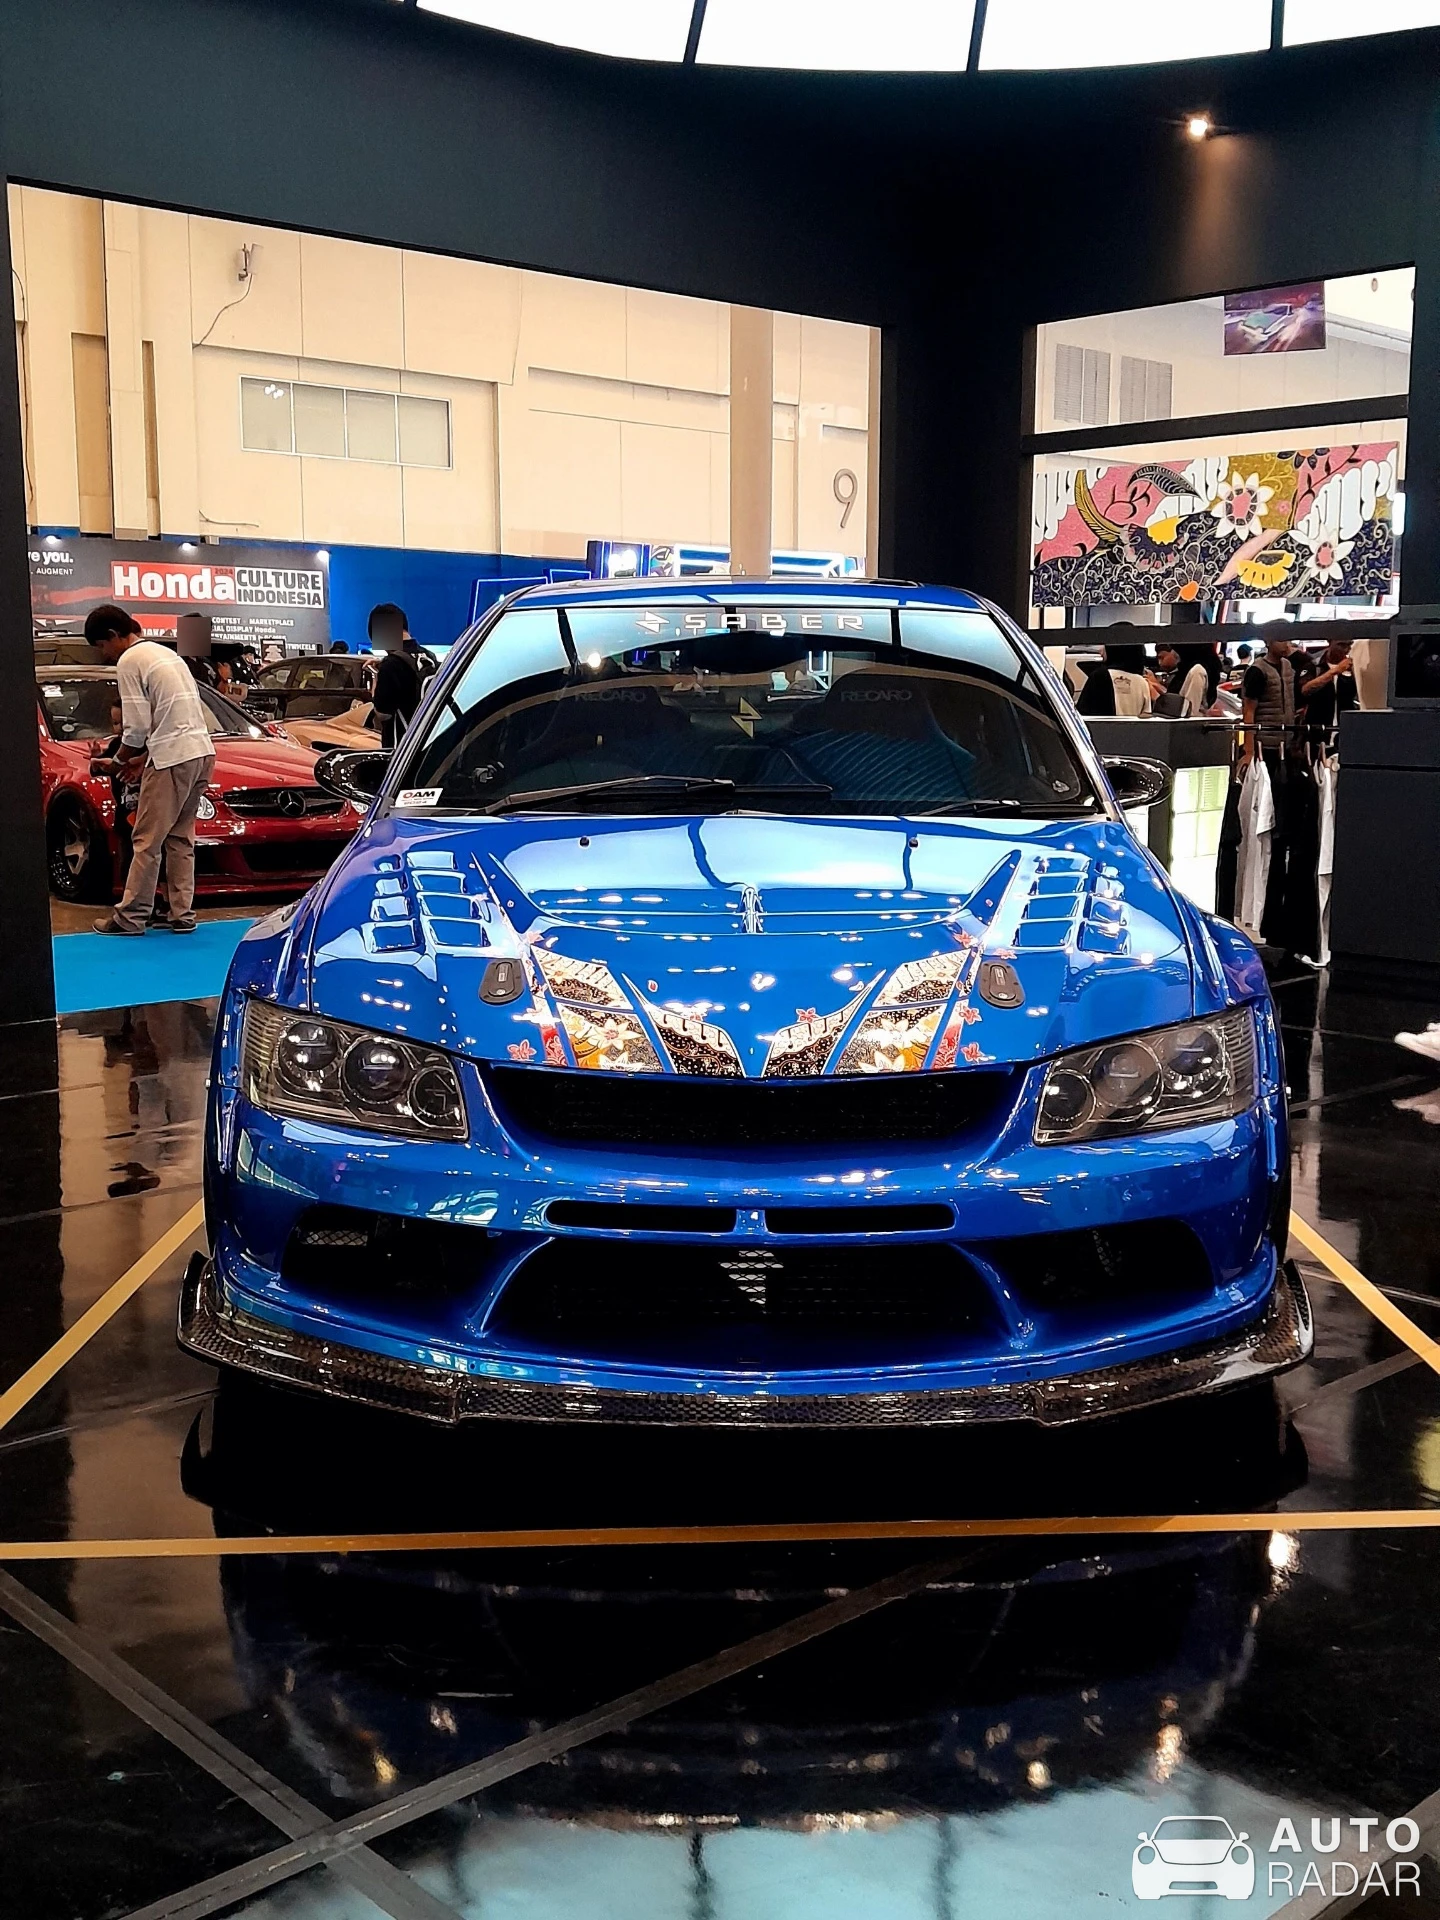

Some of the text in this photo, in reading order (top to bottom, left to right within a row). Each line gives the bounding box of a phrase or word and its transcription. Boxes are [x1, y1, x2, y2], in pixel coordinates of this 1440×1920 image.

[833, 468, 858, 529] 9
[42, 551, 74, 565] you.
[36, 567, 74, 575] AUGMENT
[236, 569, 321, 590] CULTURE
[113, 565, 235, 601] Honda
[237, 588, 322, 606] INDONESIA
[684, 613, 864, 630] SABER
[841, 689, 912, 701] RECARO
